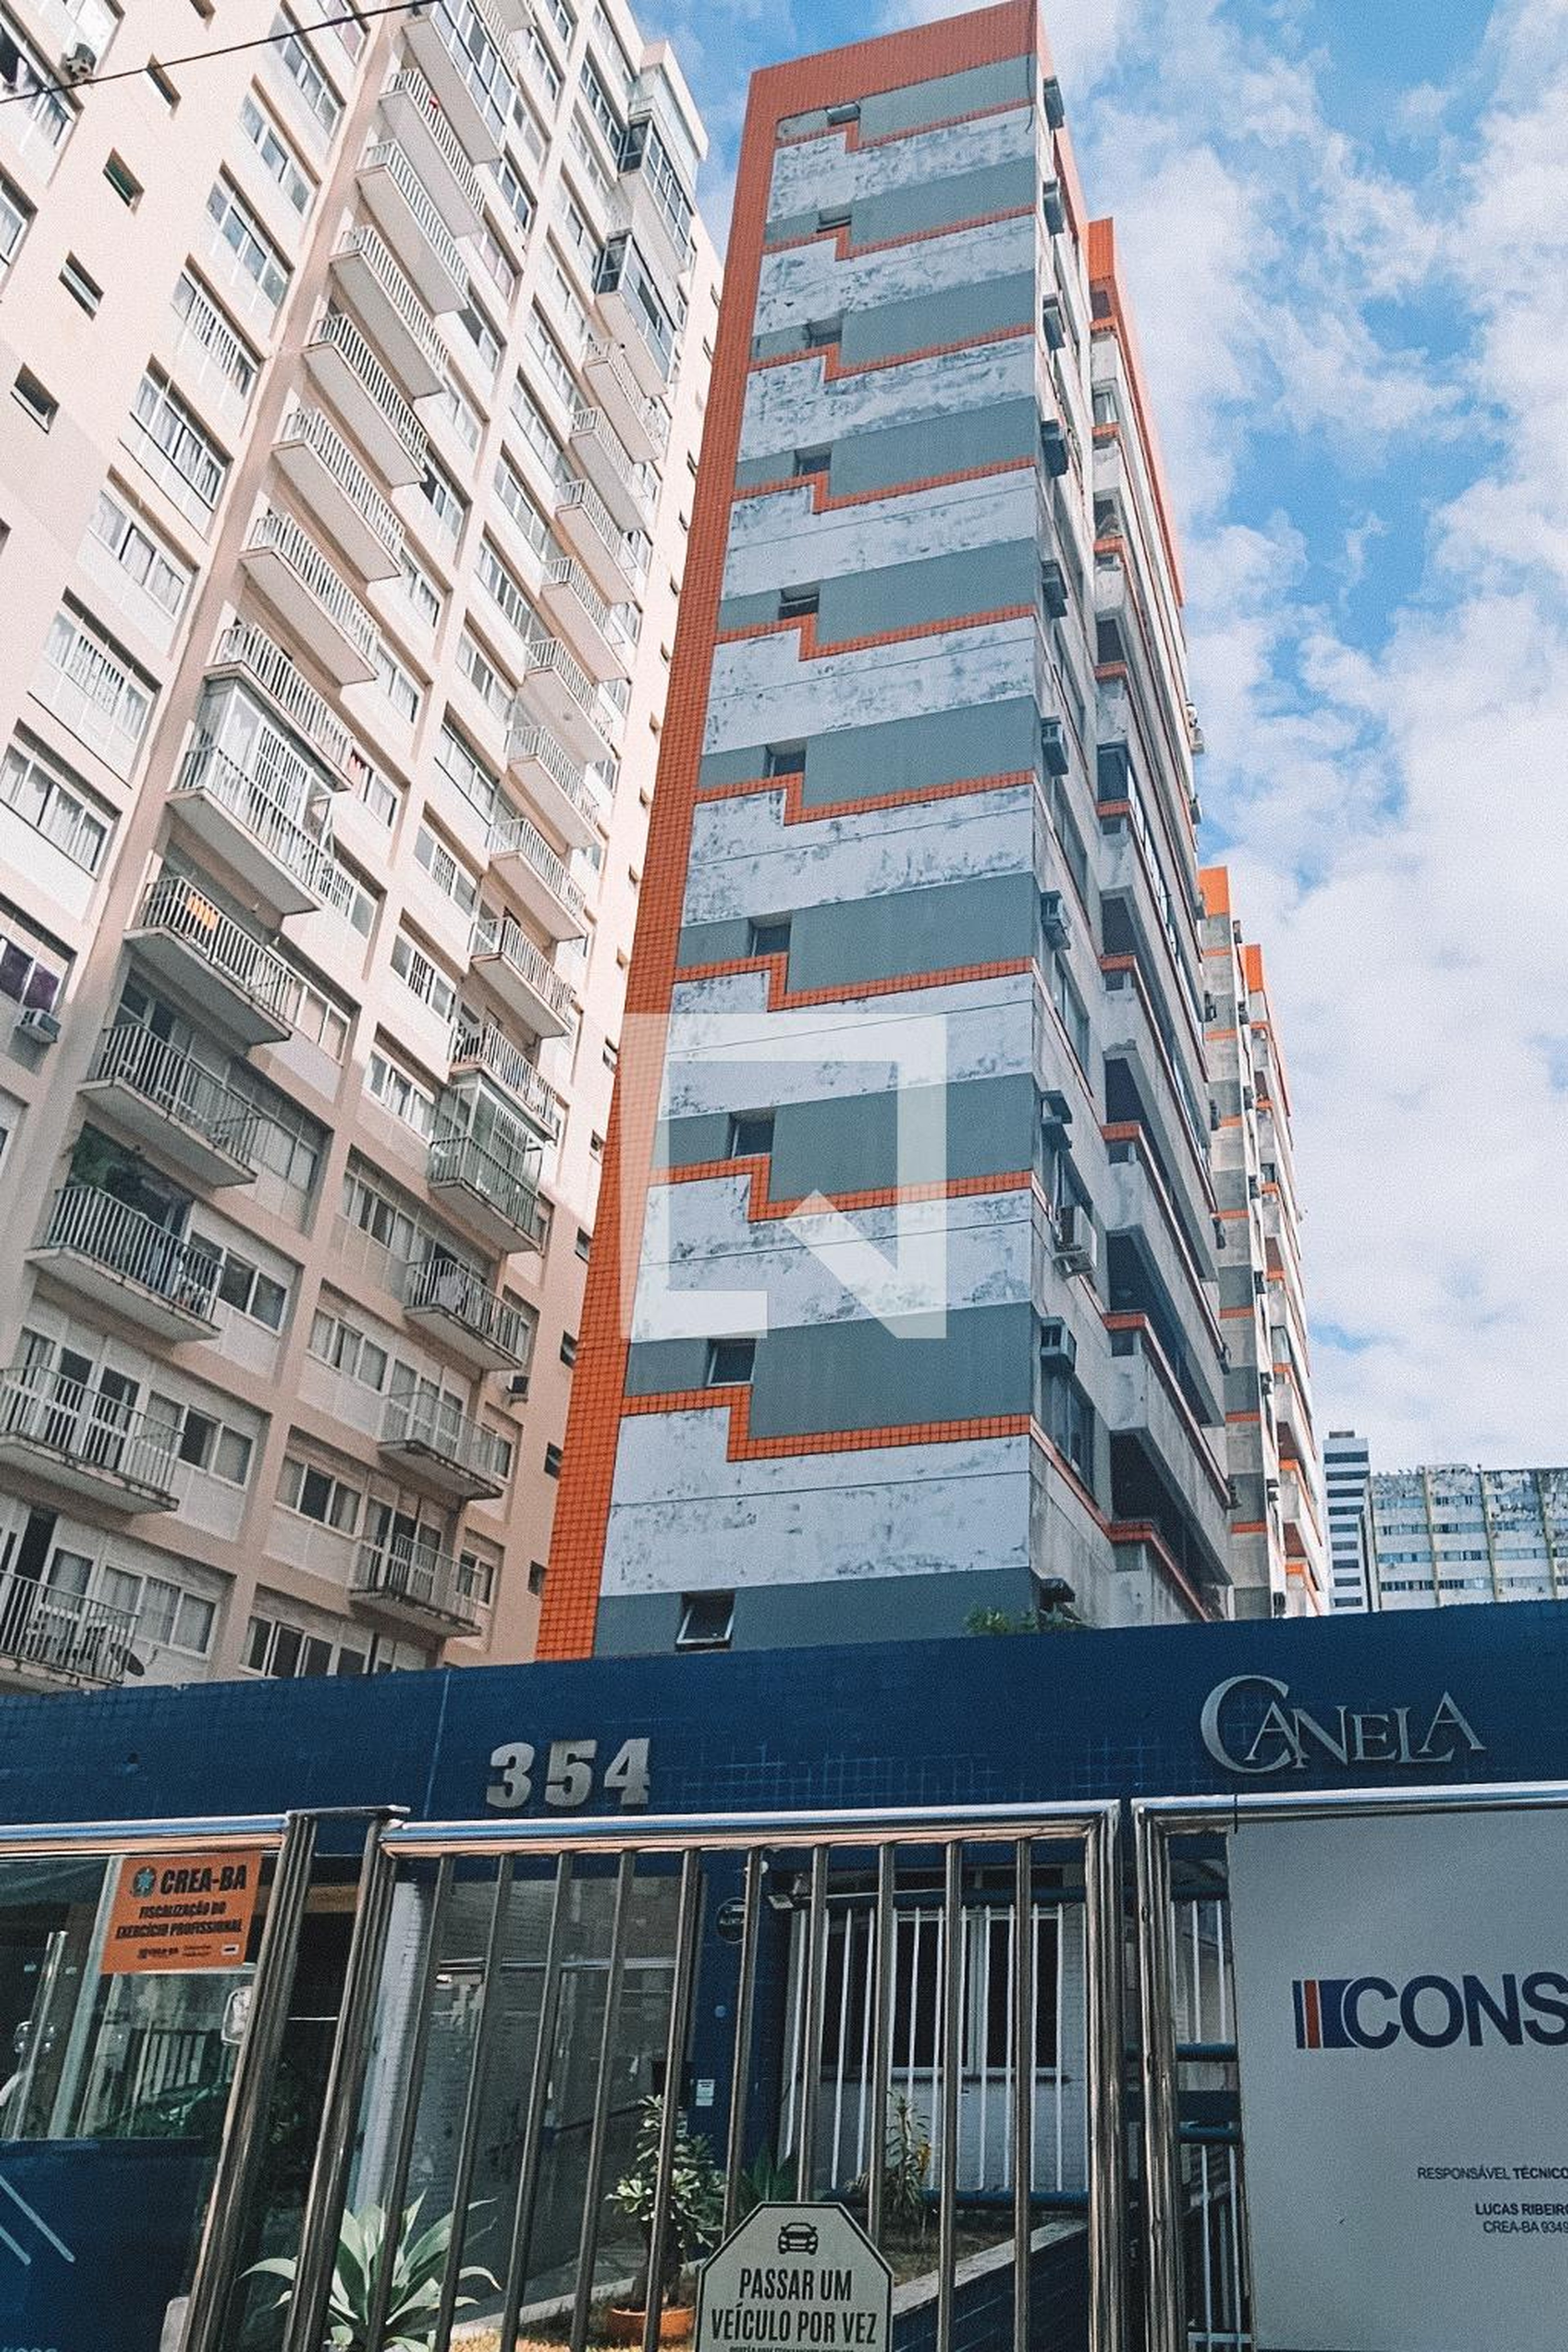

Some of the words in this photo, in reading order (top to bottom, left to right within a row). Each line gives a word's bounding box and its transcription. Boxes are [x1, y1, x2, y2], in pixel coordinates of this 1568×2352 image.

[1200, 1675, 1487, 1773] CANELA
[486, 1738, 650, 1808] 354
[160, 1864, 247, 1894] CREA-BA
[1417, 2165, 1510, 2179] RESPONSÁVEL
[1475, 2203, 1519, 2215] LUCAS
[1521, 2203, 1568, 2216] RIBEIR
[1483, 2221, 1539, 2233] CREA-BA
[739, 2268, 814, 2300] PASSAR
[820, 2269, 852, 2301] UM
[712, 2302, 791, 2342] VEÍCULO
[797, 2310, 835, 2343] POR
[843, 2312, 878, 2344] VEZ
